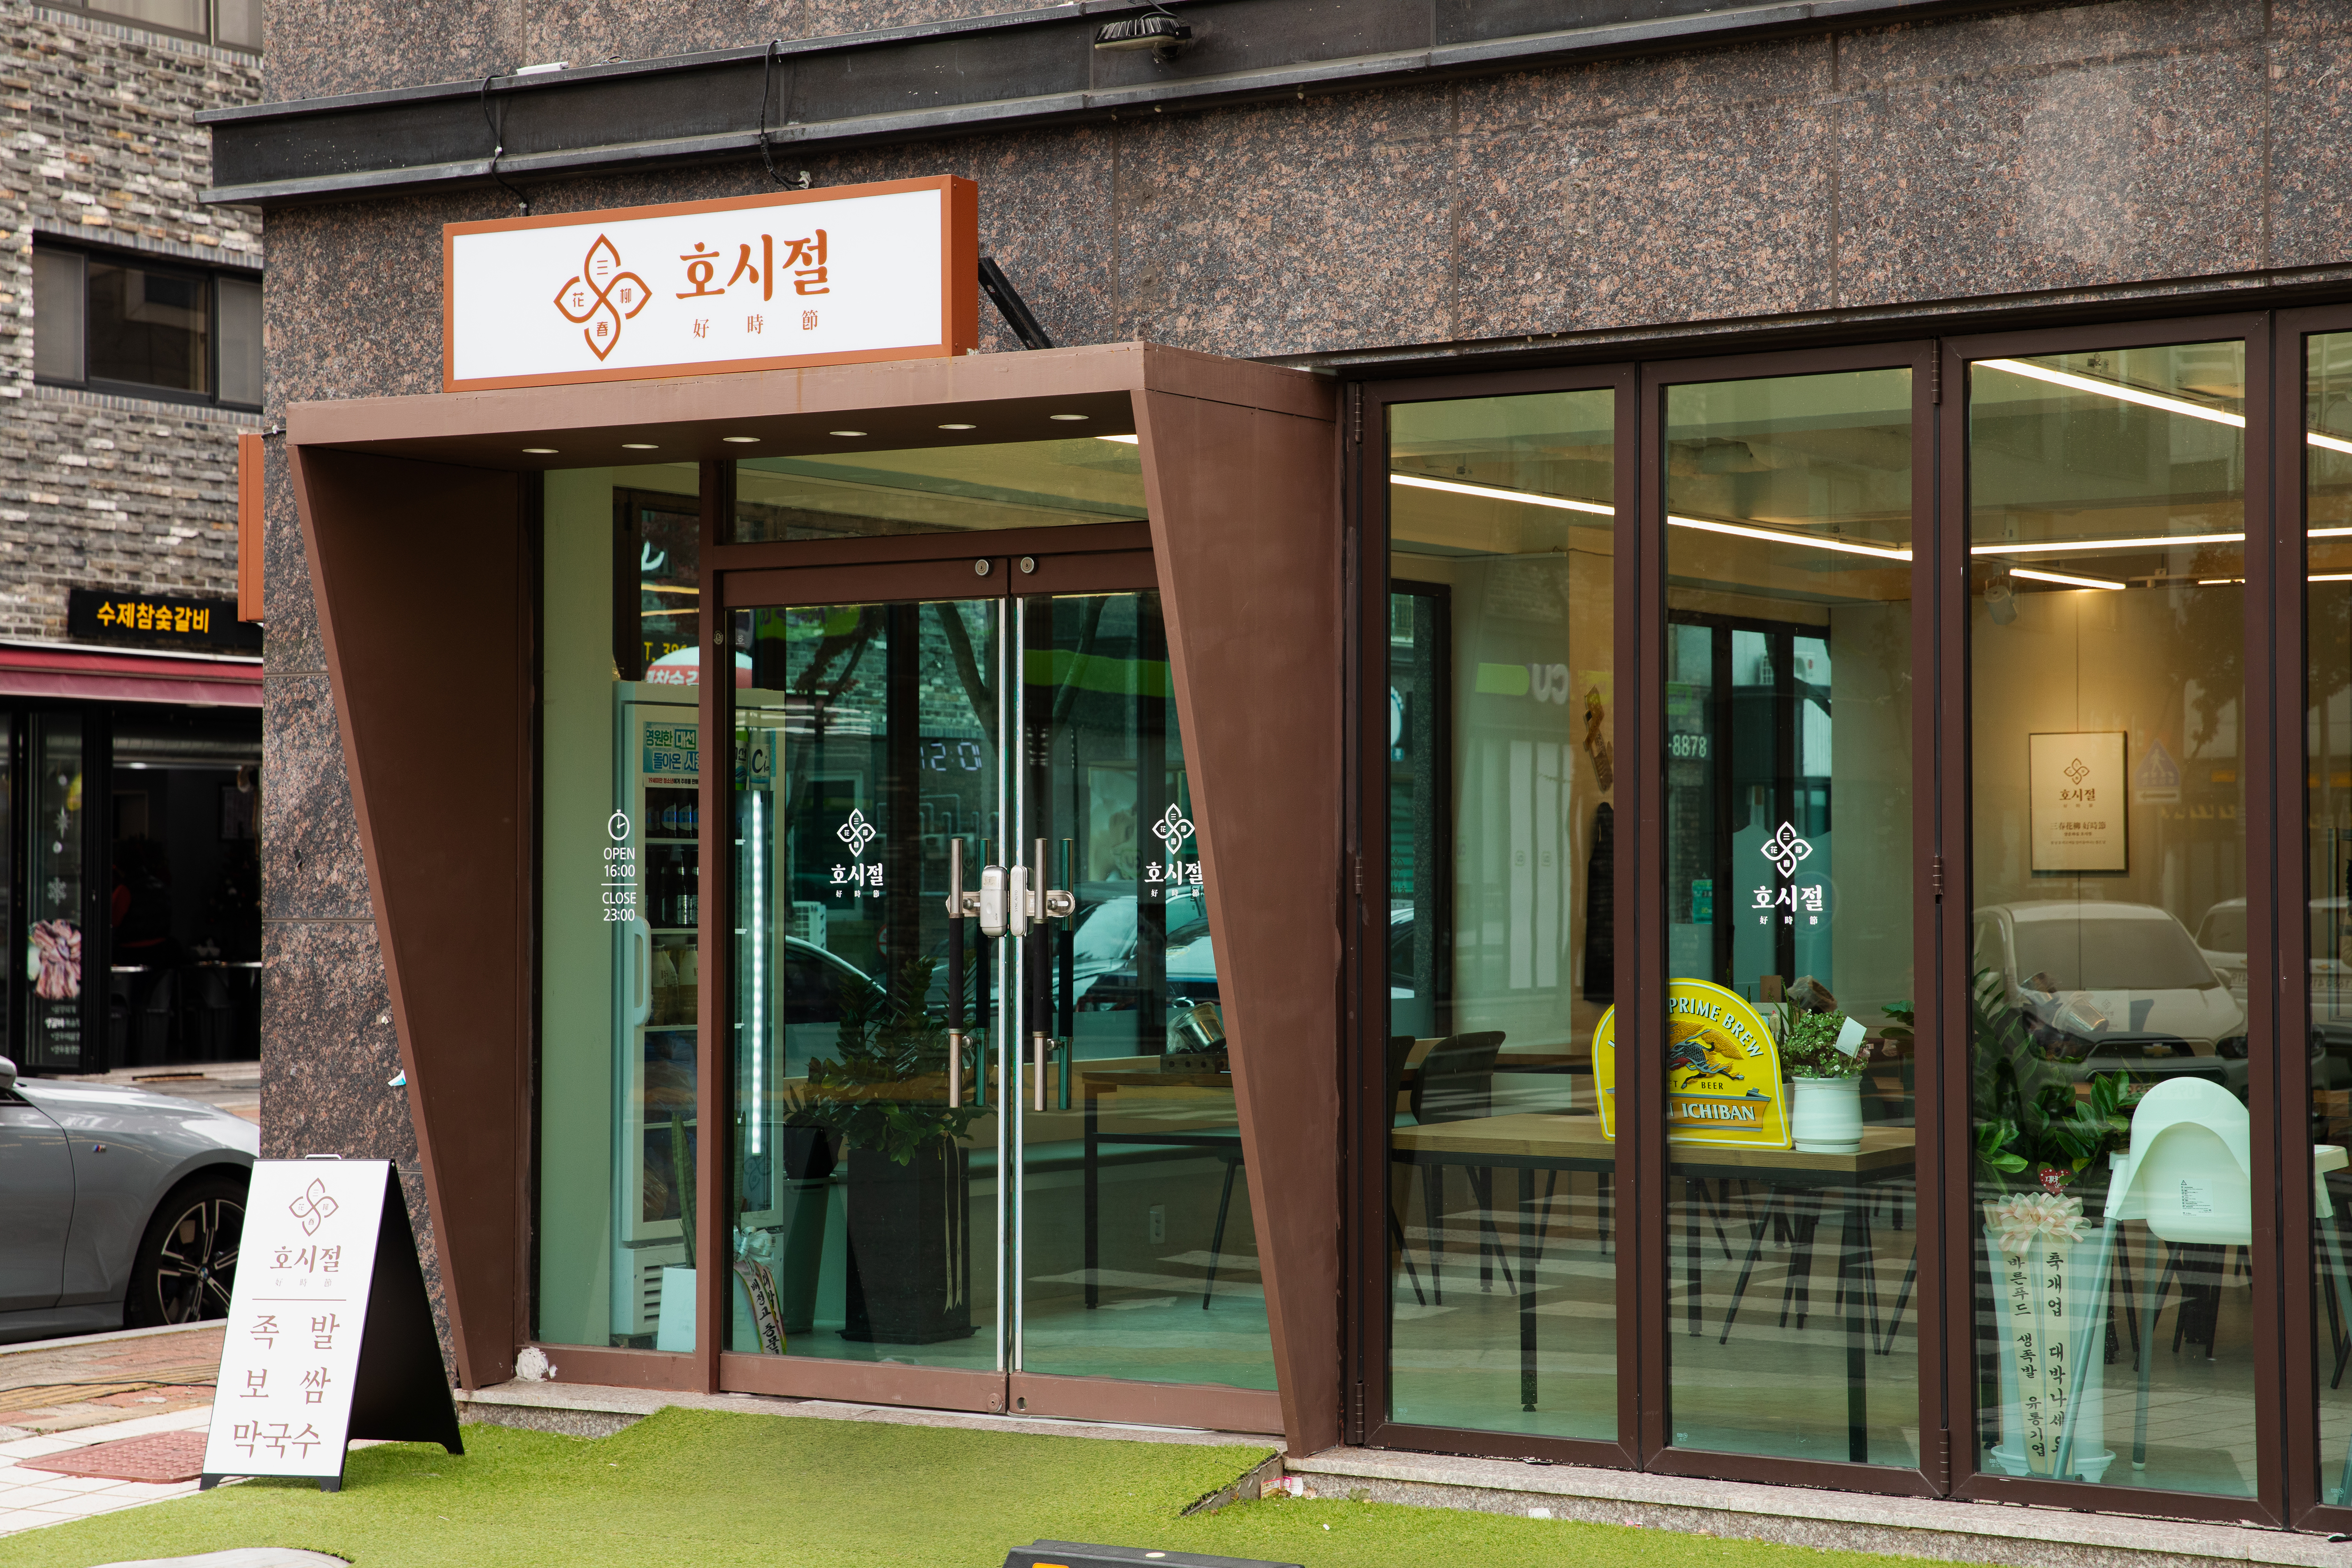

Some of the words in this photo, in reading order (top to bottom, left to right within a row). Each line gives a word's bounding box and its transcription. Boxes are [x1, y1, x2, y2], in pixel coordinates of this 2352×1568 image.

[596, 260, 608, 275] 三
[675, 229, 831, 302] 호시절
[572, 292, 584, 307] 花
[620, 288, 632, 304] 柳
[596, 321, 608, 337] 春
[692, 310, 818, 339] 好時節
[96, 601, 210, 634] 수제참숯갈비
[646, 729, 673, 747] 영원한
[675, 730, 695, 748] 대선
[653, 752, 681, 770] 돌아온
[736, 747, 747, 762] 선
[2059, 788, 2096, 802] 호시절
[604, 847, 635, 860] OPEN
[604, 864, 635, 877] 16:00
[830, 863, 883, 887] 호시절
[1144, 860, 1203, 885] 호시절
[602, 892, 636, 905] CLOSE
[1751, 884, 1823, 912] 호시절
[603, 908, 635, 922] 23:00
[1669, 997, 1721, 1022] PRIME
[1722, 1012, 1764, 1057] BREW
[1681, 1103, 1756, 1121] ICHIBAN
[270, 1245, 342, 1273] 호시절
[233, 1420, 321, 1460] 막국수
